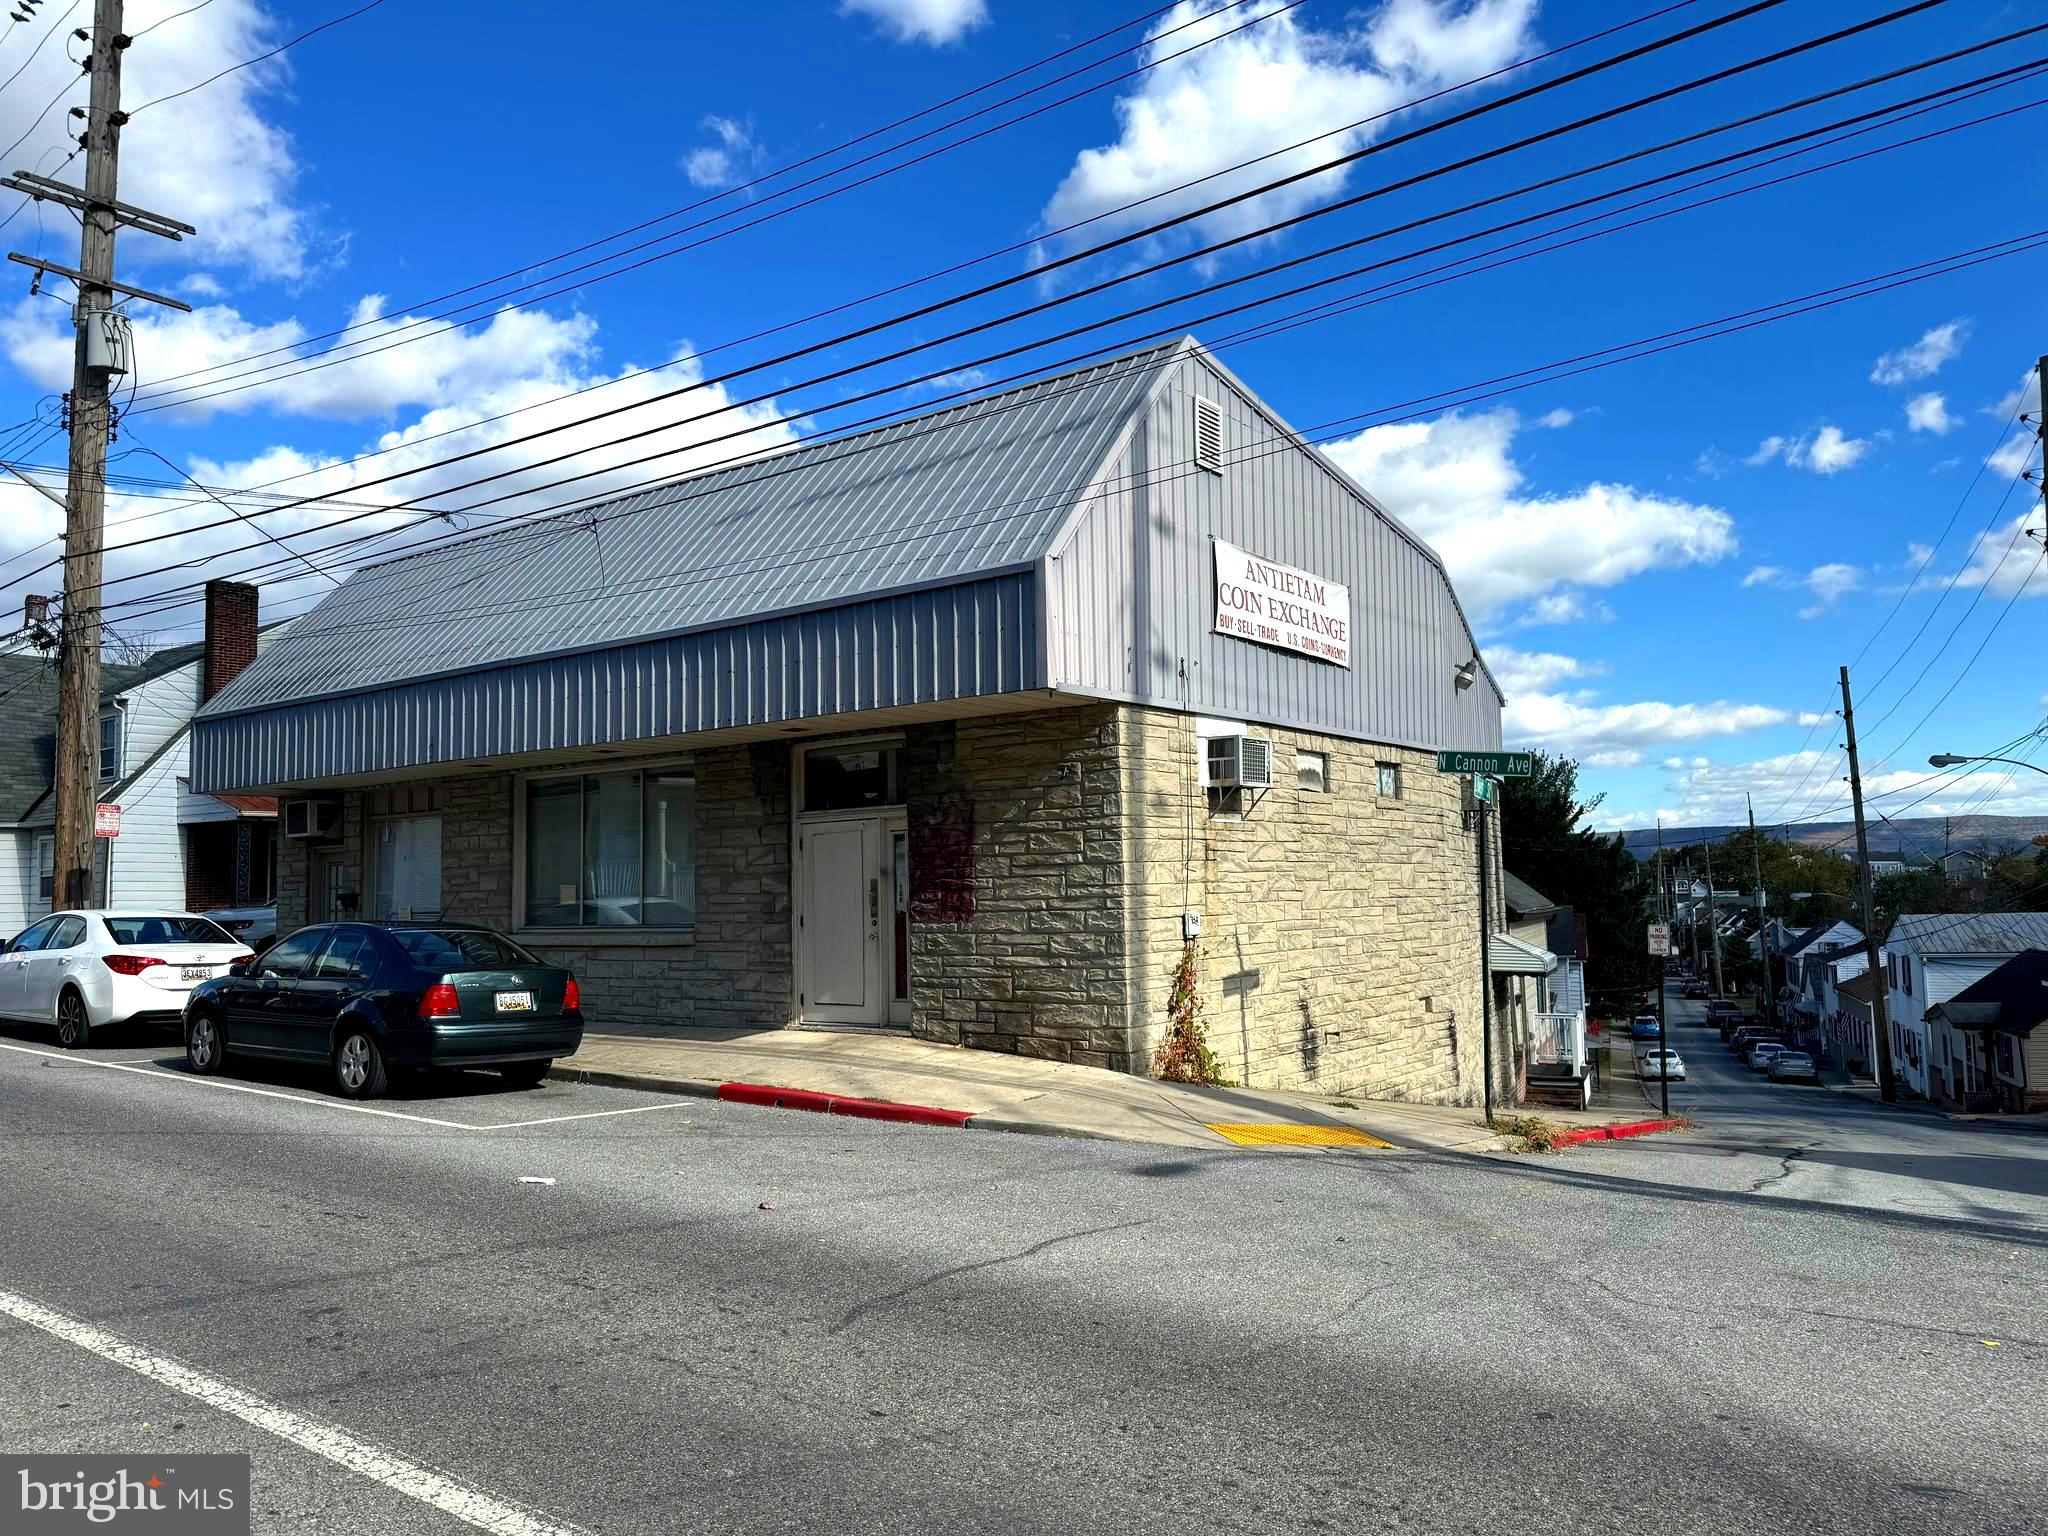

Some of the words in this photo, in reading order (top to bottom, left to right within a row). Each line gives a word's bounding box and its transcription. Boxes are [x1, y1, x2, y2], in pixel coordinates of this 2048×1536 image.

[1245, 559, 1326, 607] ANTIETAM
[1219, 582, 1263, 616] COIN
[1267, 597, 1347, 642] EXCHANGE
[1438, 753, 1447, 770] N
[1455, 754, 1498, 772] Cannon
[1507, 755, 1529, 773] Ave
